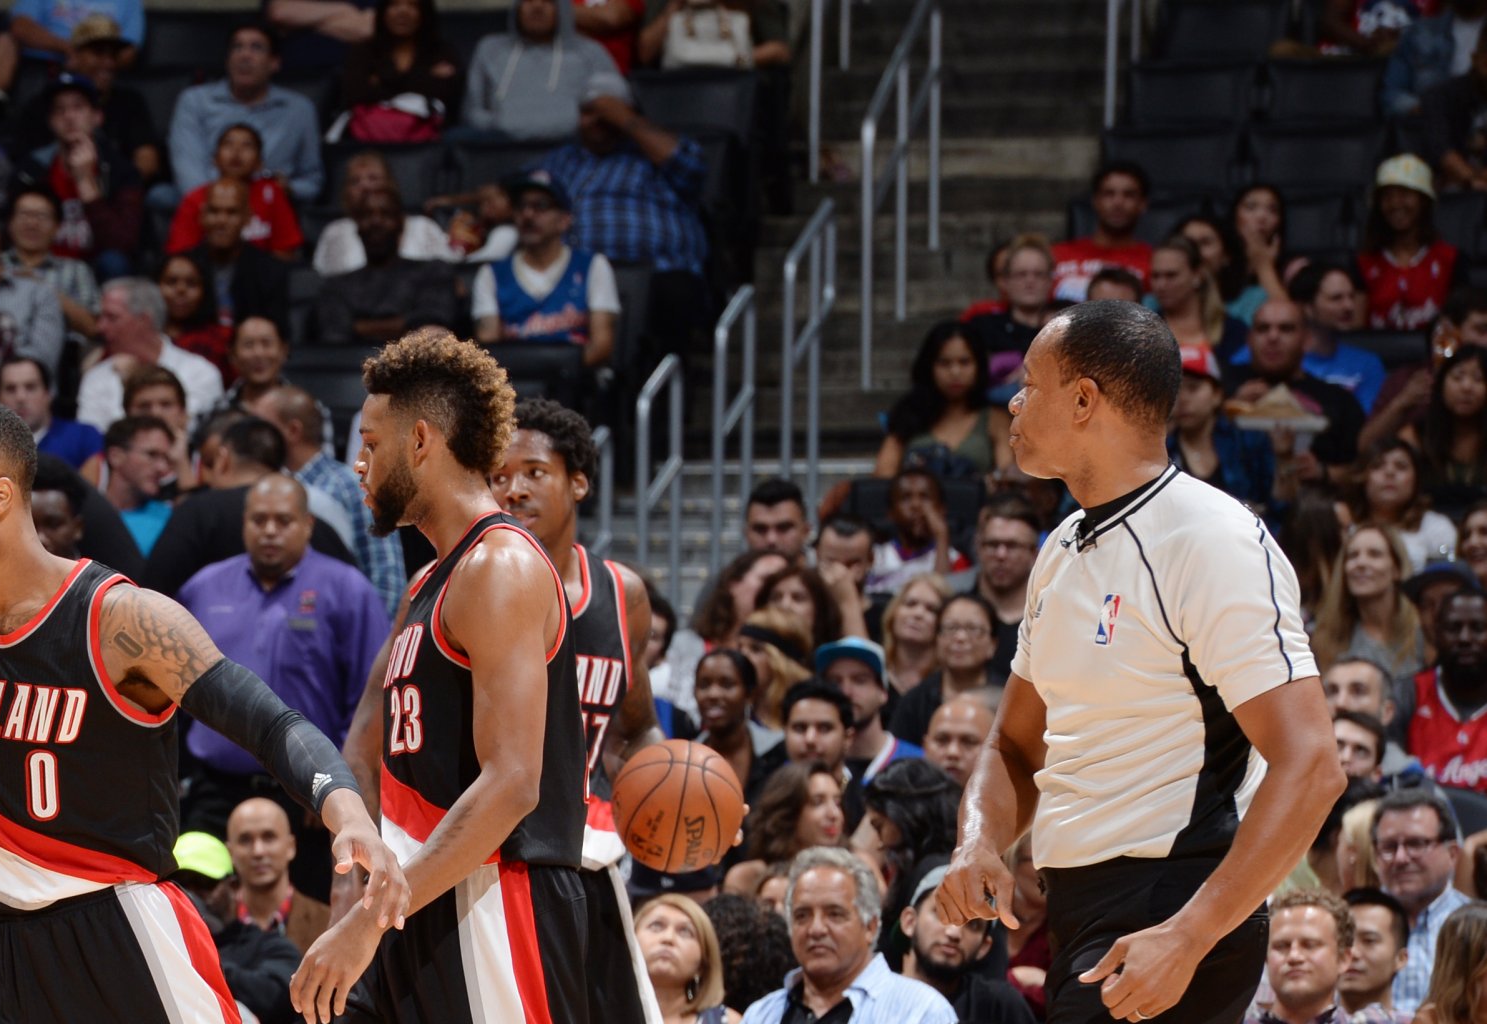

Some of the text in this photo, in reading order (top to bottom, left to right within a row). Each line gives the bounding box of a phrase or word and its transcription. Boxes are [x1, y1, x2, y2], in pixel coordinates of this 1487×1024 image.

[389, 684, 424, 757] 23
[580, 710, 610, 772] 7
[24, 749, 61, 823] 0
